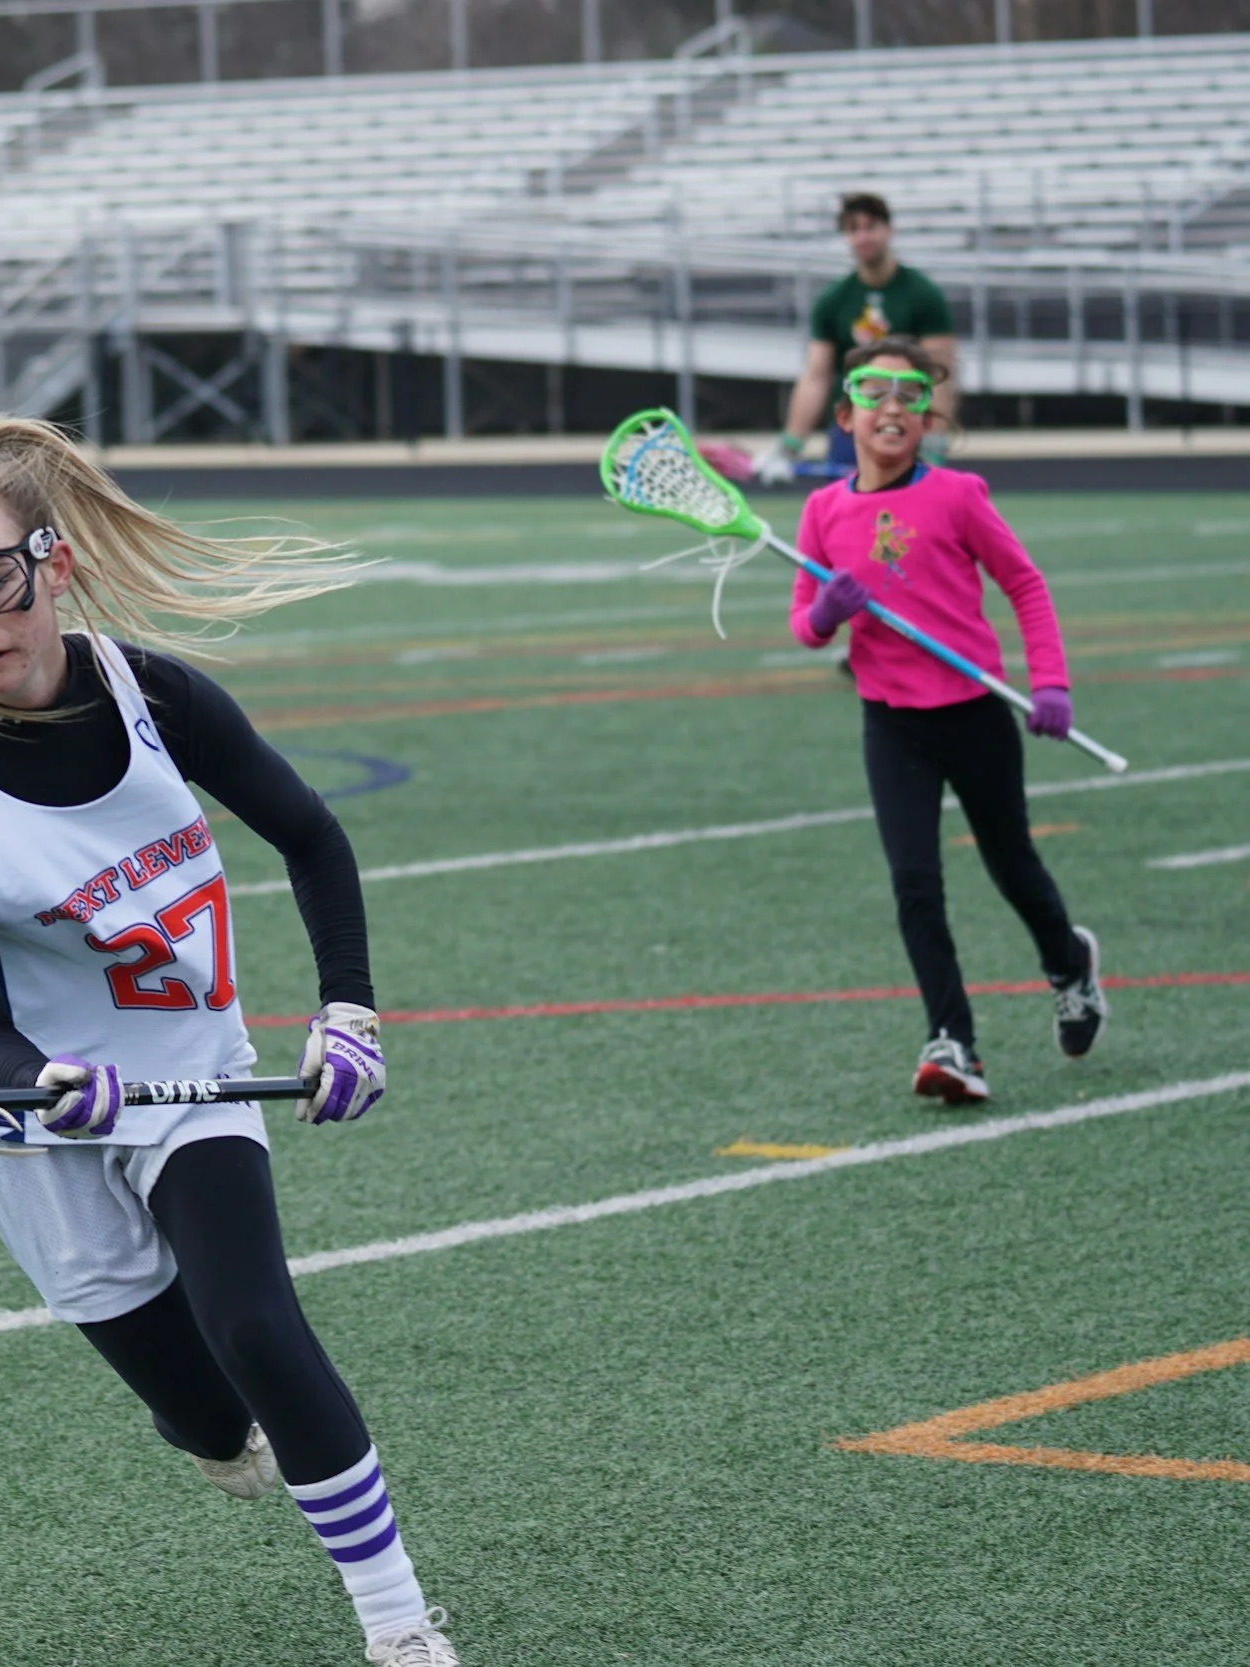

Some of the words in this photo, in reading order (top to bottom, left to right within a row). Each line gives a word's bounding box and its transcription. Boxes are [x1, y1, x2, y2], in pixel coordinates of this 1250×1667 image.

[34, 866, 120, 926] NEXT
[85, 870, 236, 1011] 27
[332, 1041, 377, 1083] BRINE
